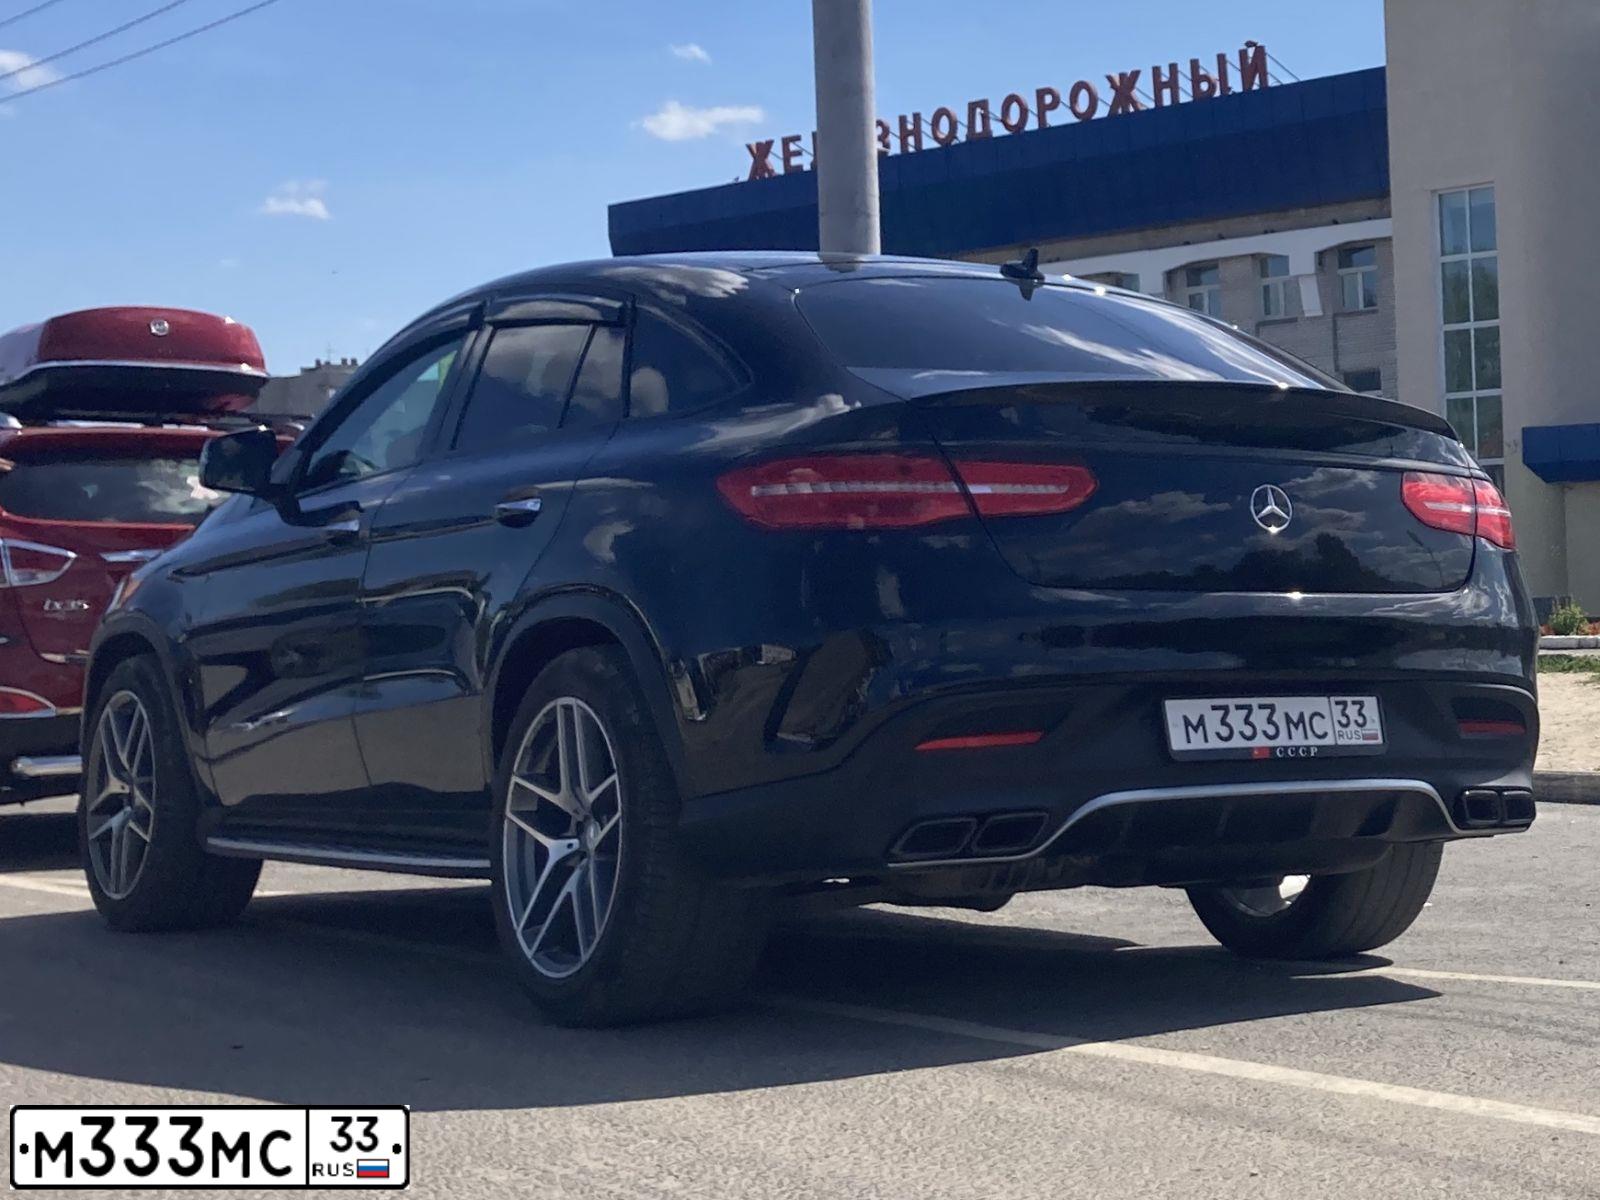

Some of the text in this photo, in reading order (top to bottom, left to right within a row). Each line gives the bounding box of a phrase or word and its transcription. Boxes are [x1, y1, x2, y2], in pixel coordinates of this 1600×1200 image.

[1335, 700, 1367, 728] 33
[1337, 729, 1362, 740] RUS
[1276, 746, 1318, 758] СССР
